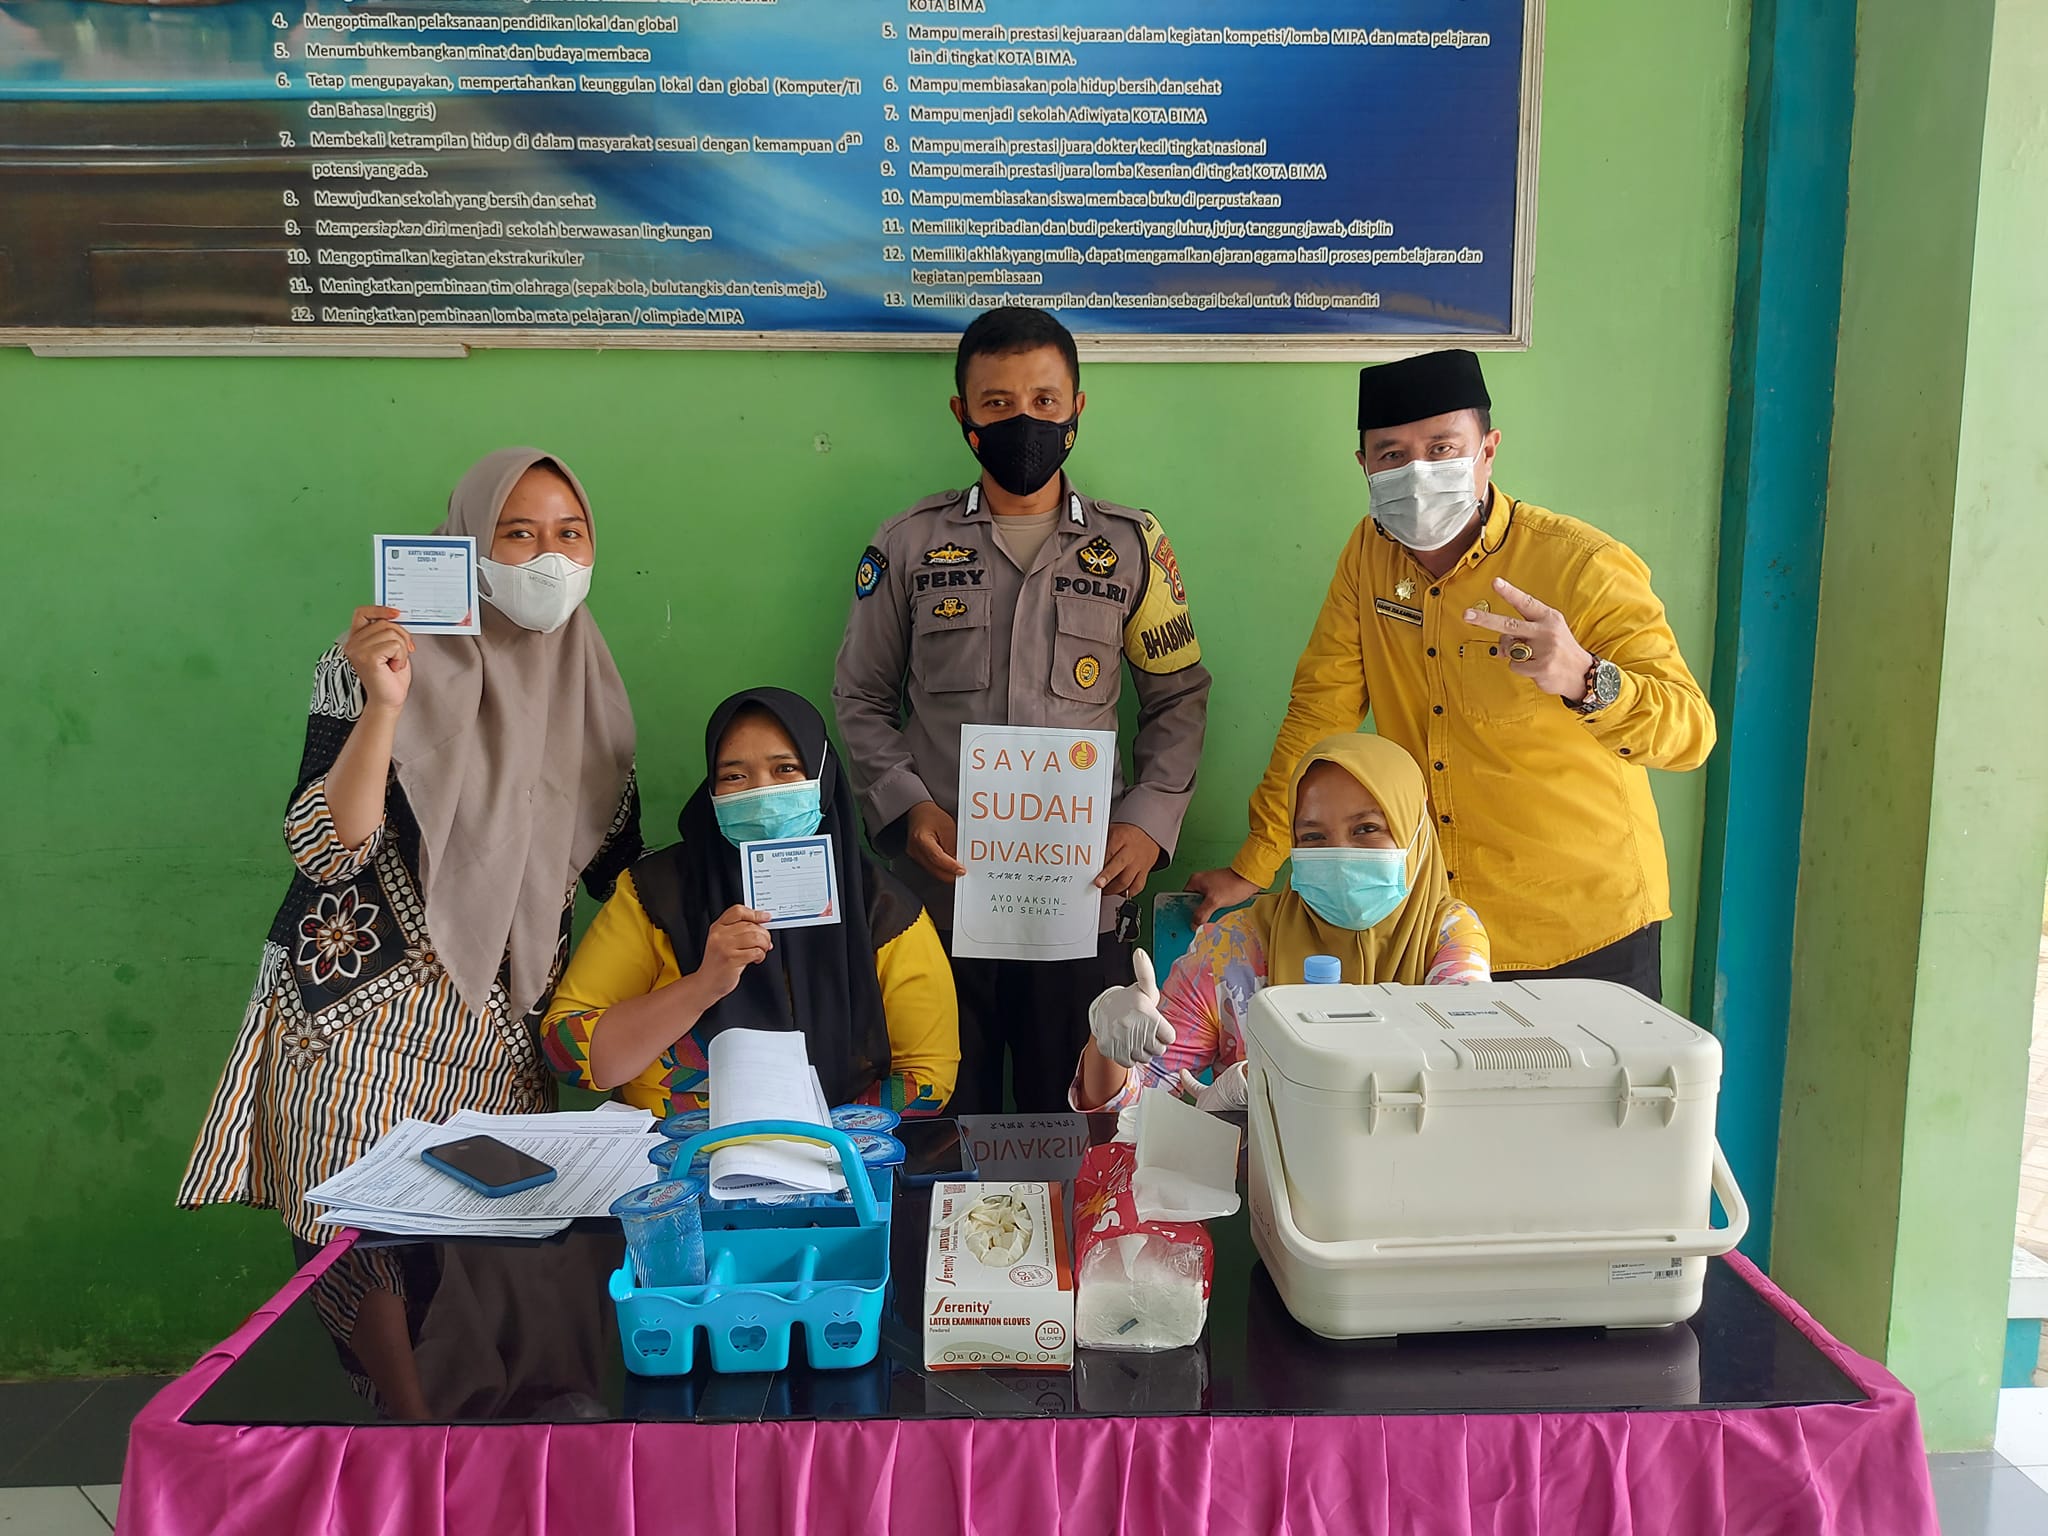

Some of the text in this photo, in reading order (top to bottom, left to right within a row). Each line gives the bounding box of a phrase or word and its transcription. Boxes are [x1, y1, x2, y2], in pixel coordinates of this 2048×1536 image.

[909, 0, 985, 12] KOTA BIMA
[272, 14, 678, 34] 4. Mengoptimalkan pelaksanaan pendidikan lokal dan global
[882, 25, 1490, 48] 5. Mampu meraih prestasi kejuaraan dalam kegiatan kompetisi/lomba MIPA dan mata pelajaran
[275, 43, 650, 63] 5. Menumbuhkembangkan minat dan budaya membaca
[909, 49, 1076, 67] lain di tingkat KOTA BIMA.
[278, 73, 862, 96] 6. Tetap mengupayakan, mempertahankan keunggulan lokal dan global (Komputer/TI
[884, 77, 1222, 96] 6. Mampu membiasakan pola hidup bersih dan sehat
[309, 103, 437, 121] dan Bahasa Inggris)
[885, 107, 1207, 125] 7. Mampu menjadi sekolah Adiwiyata KOTA BIMA
[280, 132, 861, 154] 7. Membekali ketrampilan hidup di dalam masyarakat sesuai dengan kemampuan dan
[313, 162, 428, 179] potensi yang ada.
[883, 191, 1282, 209] 10. Mampu membiasakan siswa membaca buku di perpustakaan
[289, 250, 583, 268] 10. Mengoptimalkan kegiatan ekstrakurikuler
[883, 248, 1484, 266] 12. Memiliki akhlak yang mulia, dapat mengamalkan ajaran agama hasil proses pembelajaran dan
[912, 269, 1042, 286] kegiatan pembiasaan
[292, 308, 744, 326] 12. Meningkatkan pembinaan lomba mata pelajaran / olimpiade MIPA
[915, 569, 985, 591] FERY
[1054, 576, 1128, 604] POLRI
[971, 748, 1062, 773] SAYA
[970, 791, 1093, 824] SUDAH
[970, 840, 1092, 866] DIVAKSIN
[987, 872, 1073, 883] KAMU KAPAN?
[990, 894, 1012, 903] AYO
[992, 905, 1014, 913] AYO
[935, 1254, 957, 1287] Serenity
[1017, 1272, 1032, 1282] ISO
[929, 1296, 990, 1316] Serenity
[929, 1317, 1030, 1326] LATEX EXAMINATION GLOVES
